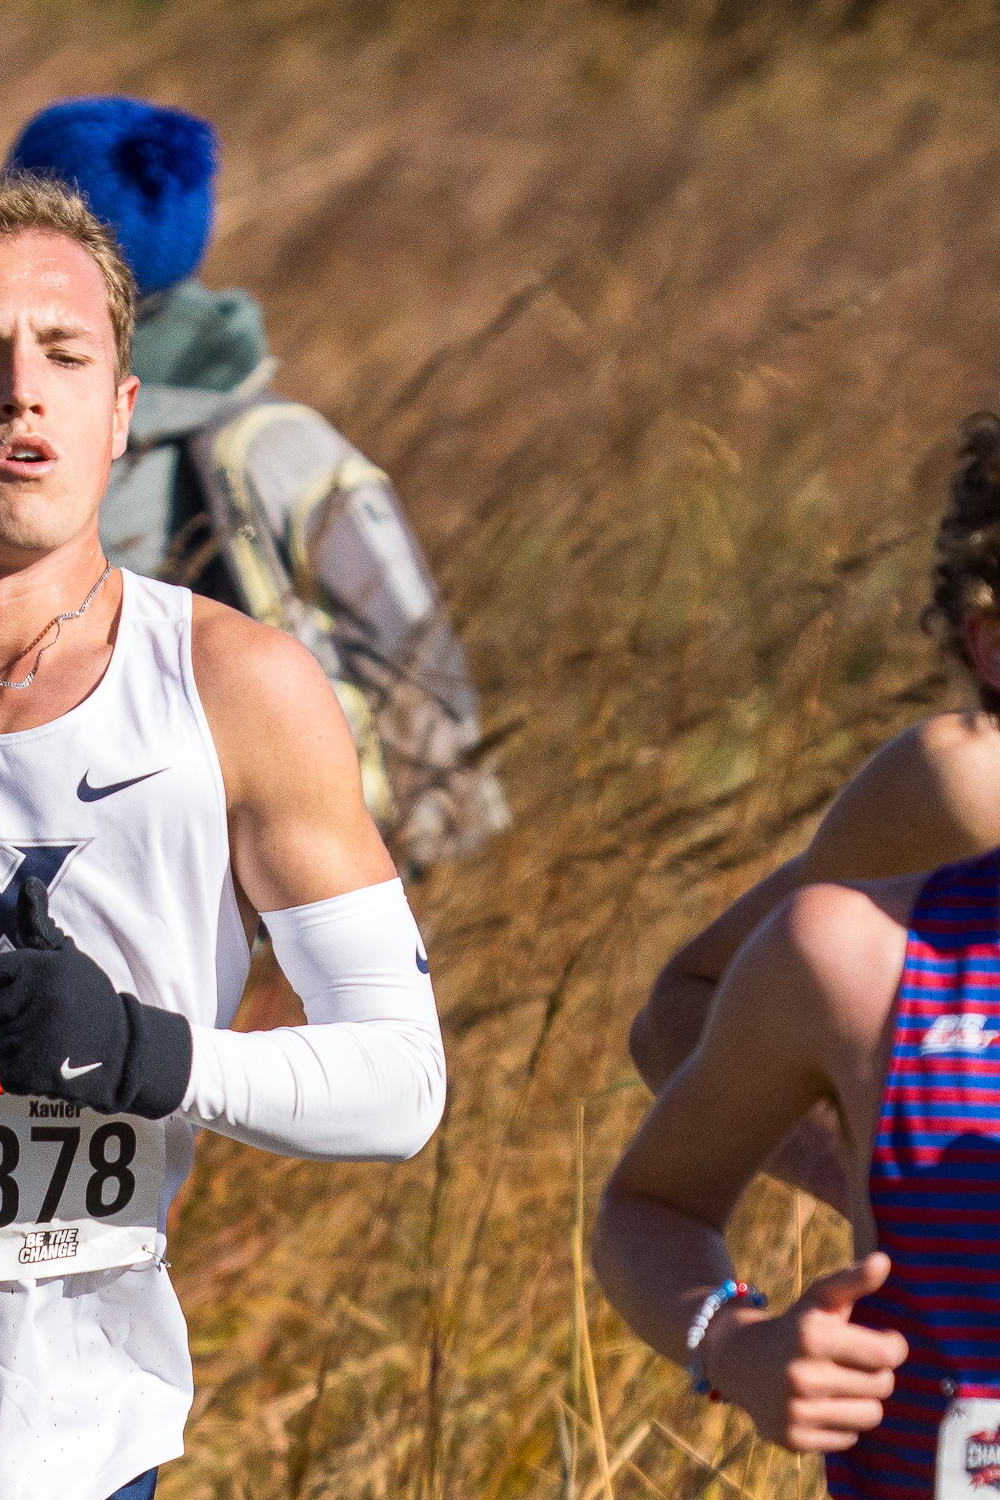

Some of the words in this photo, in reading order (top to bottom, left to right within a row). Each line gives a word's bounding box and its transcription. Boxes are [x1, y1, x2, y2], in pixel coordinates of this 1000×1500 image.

[25, 1231, 46, 1248] BE
[48, 1228, 79, 1245] THE
[18, 1242, 79, 1264] CHANGE
